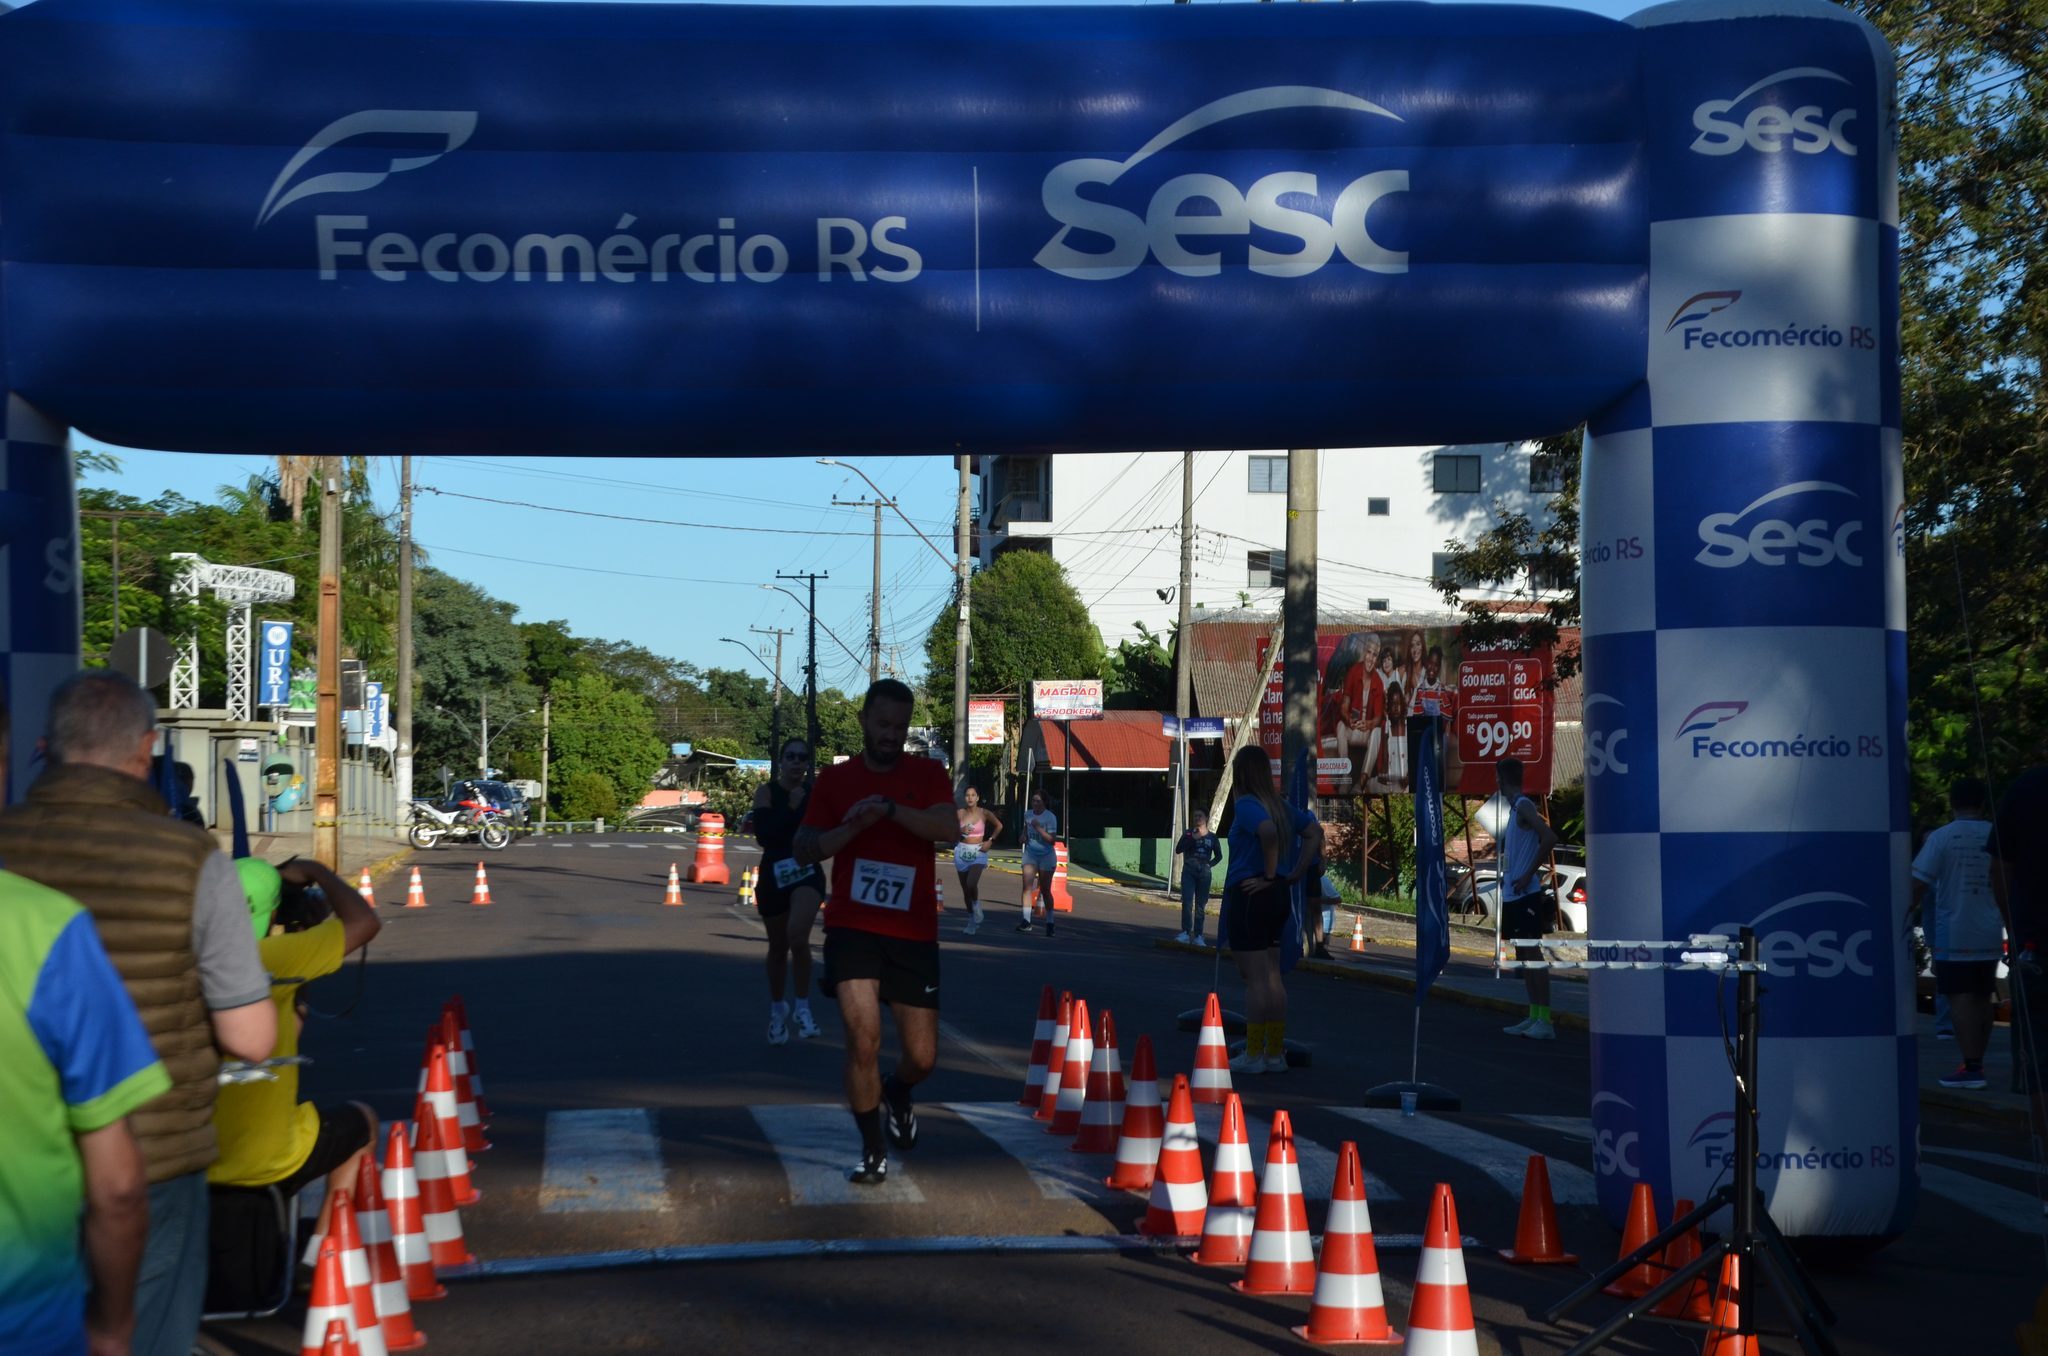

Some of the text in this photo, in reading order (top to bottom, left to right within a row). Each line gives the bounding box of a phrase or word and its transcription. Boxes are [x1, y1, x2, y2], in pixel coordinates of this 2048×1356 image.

[315, 212, 924, 283] Fecomércio RS
[1684, 322, 1875, 350] Fecomércio RS
[1616, 537, 1644, 560] RS
[267, 649, 286, 702] URI
[1462, 674, 1505, 687] 600 MEGA
[1514, 672, 1527, 685] 60
[1514, 688, 1536, 700] GIGA
[1466, 723, 1476, 735] R$
[1476, 720, 1532, 757] 99,90
[1692, 734, 1884, 758] Fecomércio RS
[861, 876, 905, 905] 767
[1705, 1145, 1895, 1169] Feomércio RS
